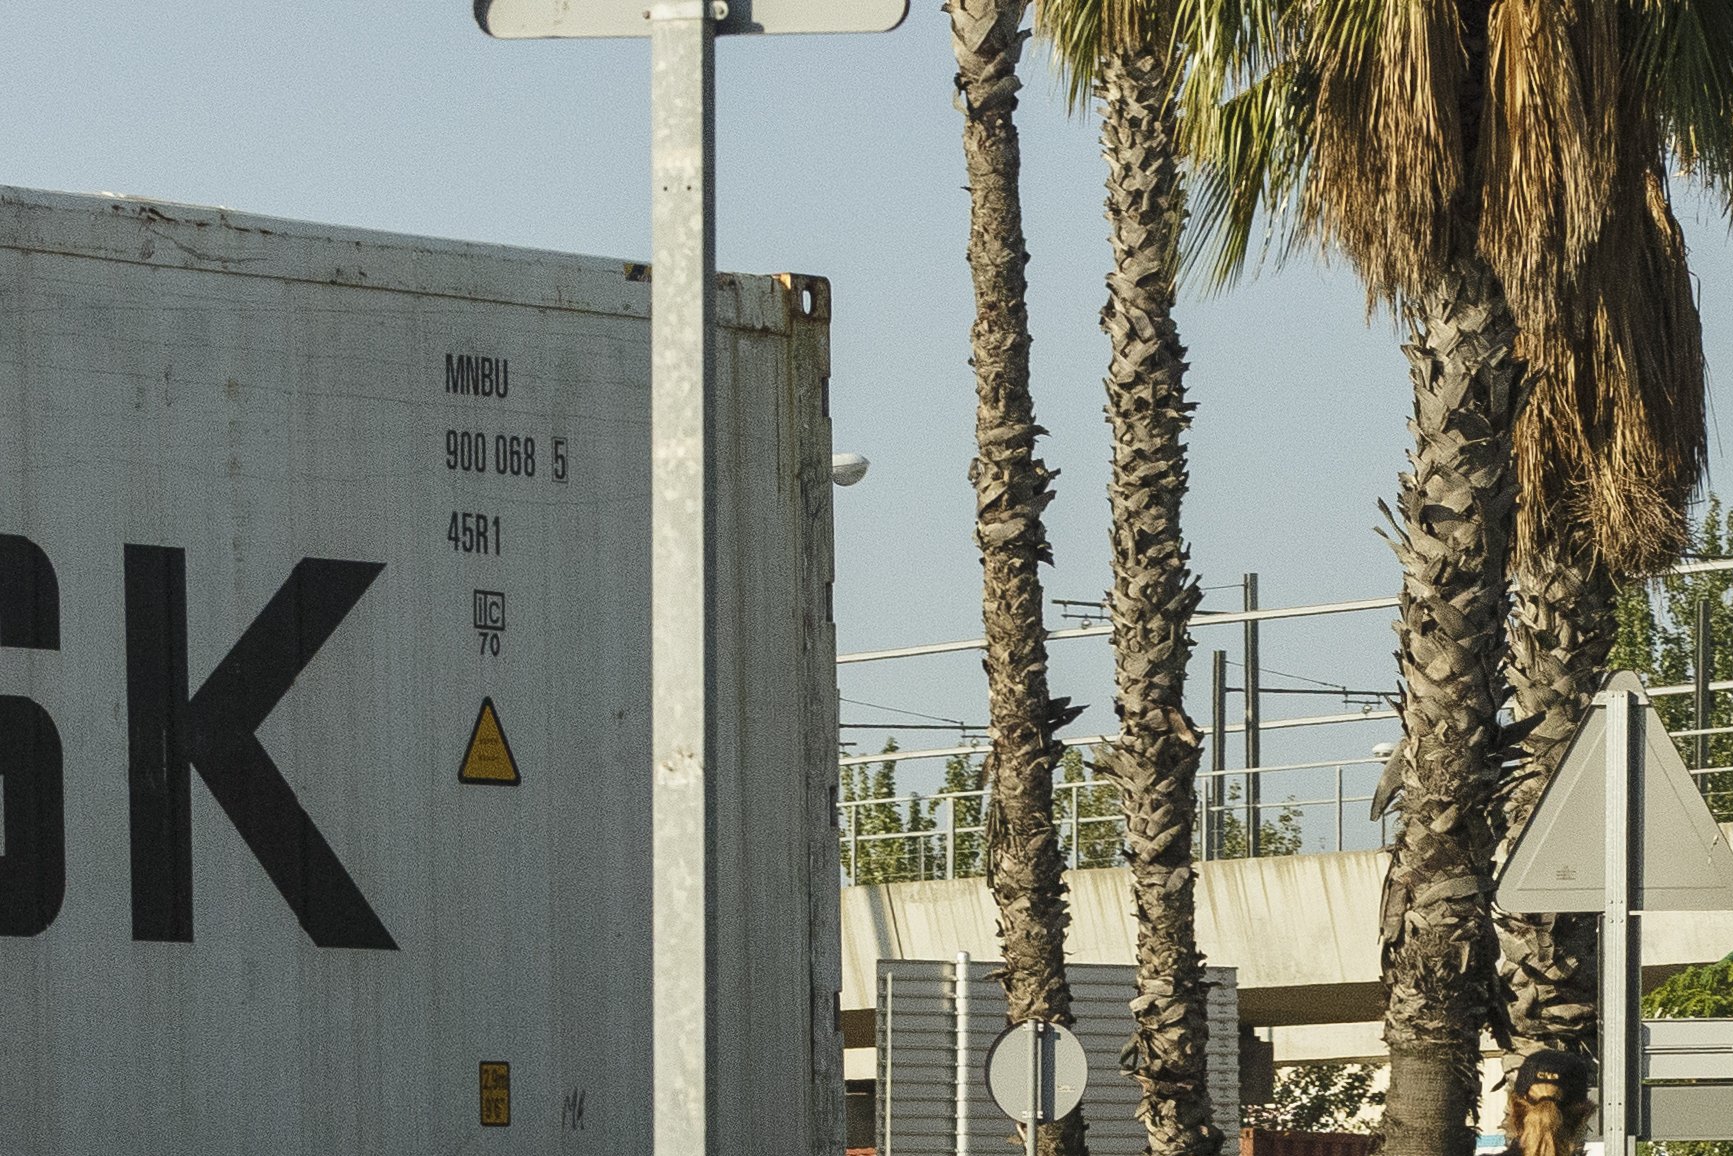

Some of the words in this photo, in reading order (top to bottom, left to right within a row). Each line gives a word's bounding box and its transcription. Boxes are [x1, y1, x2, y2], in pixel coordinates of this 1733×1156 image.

[445, 353, 508, 399] MNBU
[446, 429, 487, 473] 900
[495, 434, 536, 477] 068
[553, 438, 567, 481] 5
[447, 510, 500, 556] 45R1
[478, 632, 501, 657] 70
